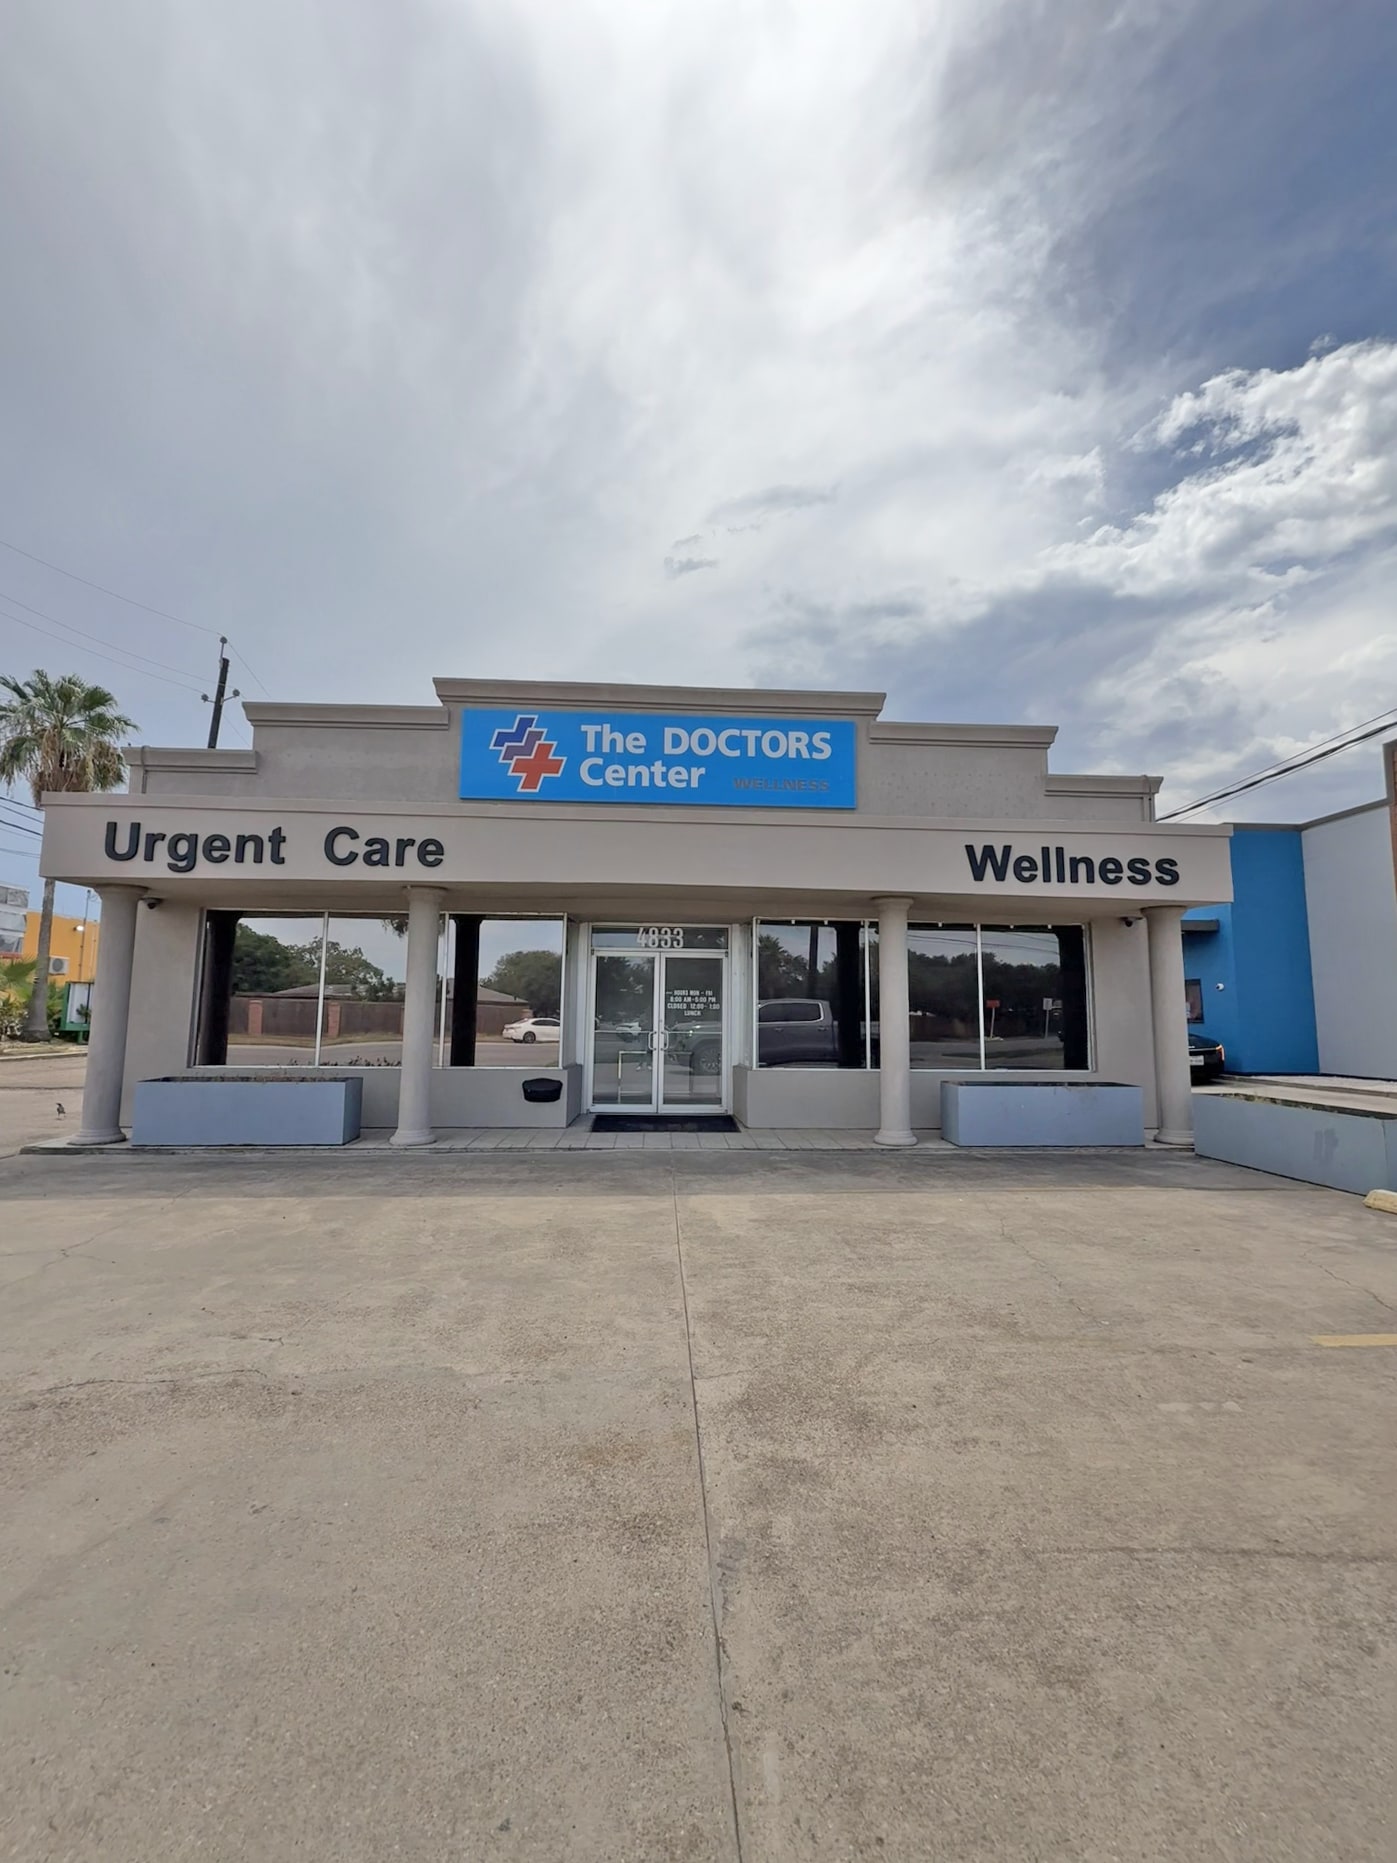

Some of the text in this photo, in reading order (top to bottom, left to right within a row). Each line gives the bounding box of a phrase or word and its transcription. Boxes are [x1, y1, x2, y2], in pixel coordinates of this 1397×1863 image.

[580, 723, 832, 760] The DOCTORS
[579, 757, 706, 788] Center
[734, 777, 830, 792] WELLNESS
[104, 821, 445, 872] Urgent Care
[965, 844, 1180, 886] Wellness
[637, 927, 684, 948] 4833
